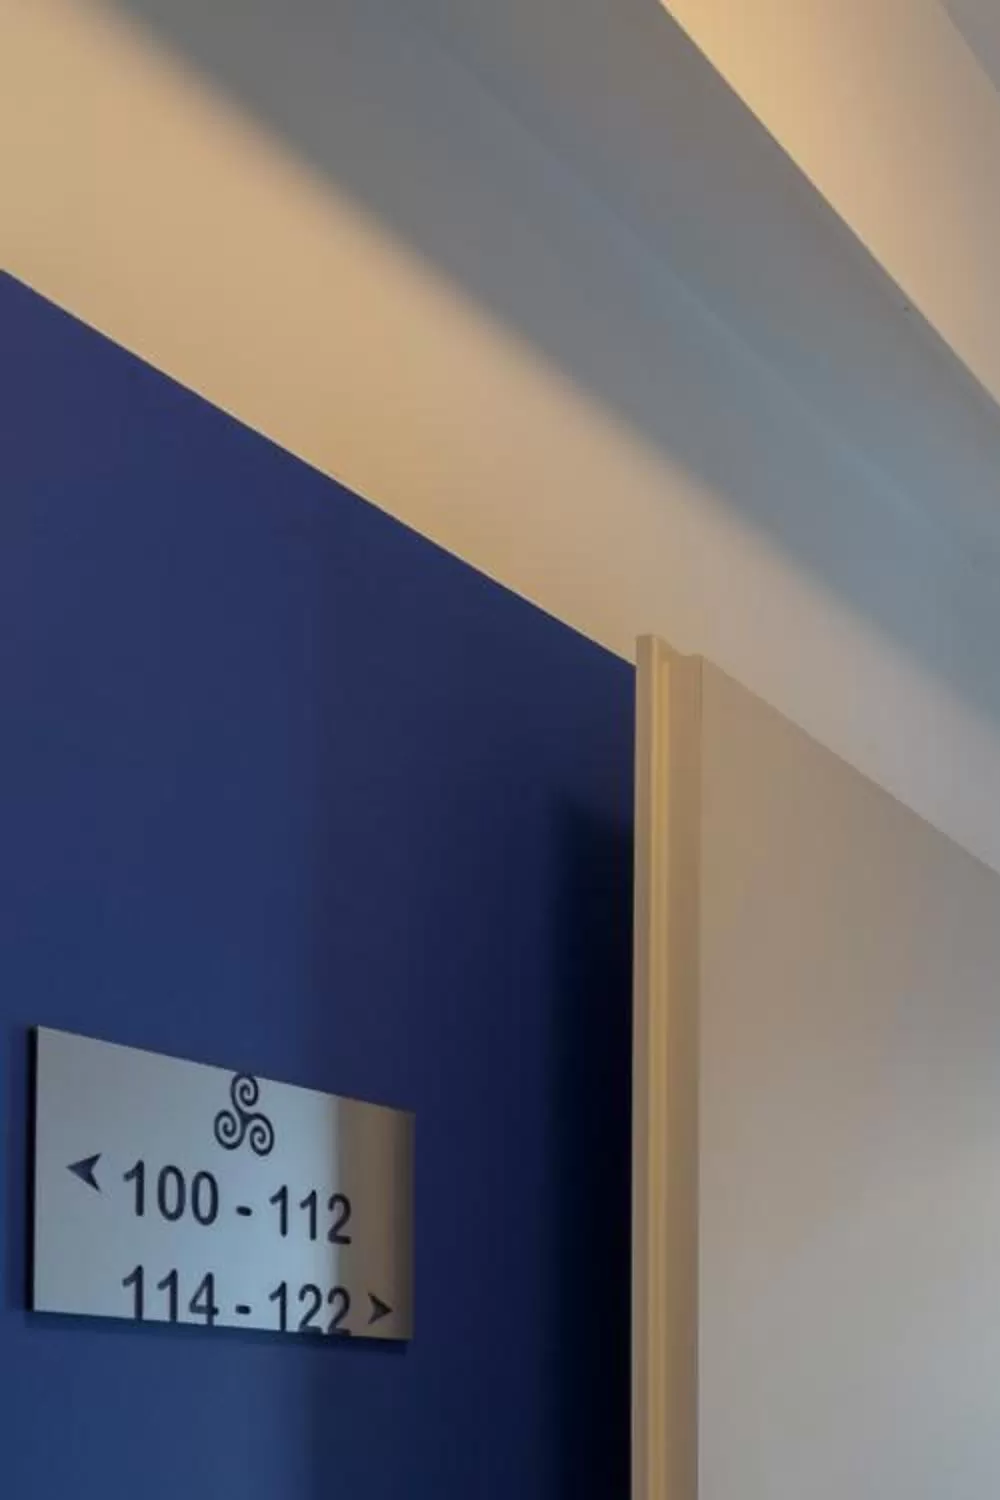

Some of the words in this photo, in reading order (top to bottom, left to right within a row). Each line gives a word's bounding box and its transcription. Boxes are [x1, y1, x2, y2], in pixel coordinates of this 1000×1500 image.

[123, 1160, 219, 1226] 100
[269, 1185, 352, 1245] 112
[122, 1264, 219, 1326] 114
[269, 1282, 352, 1336] 122
